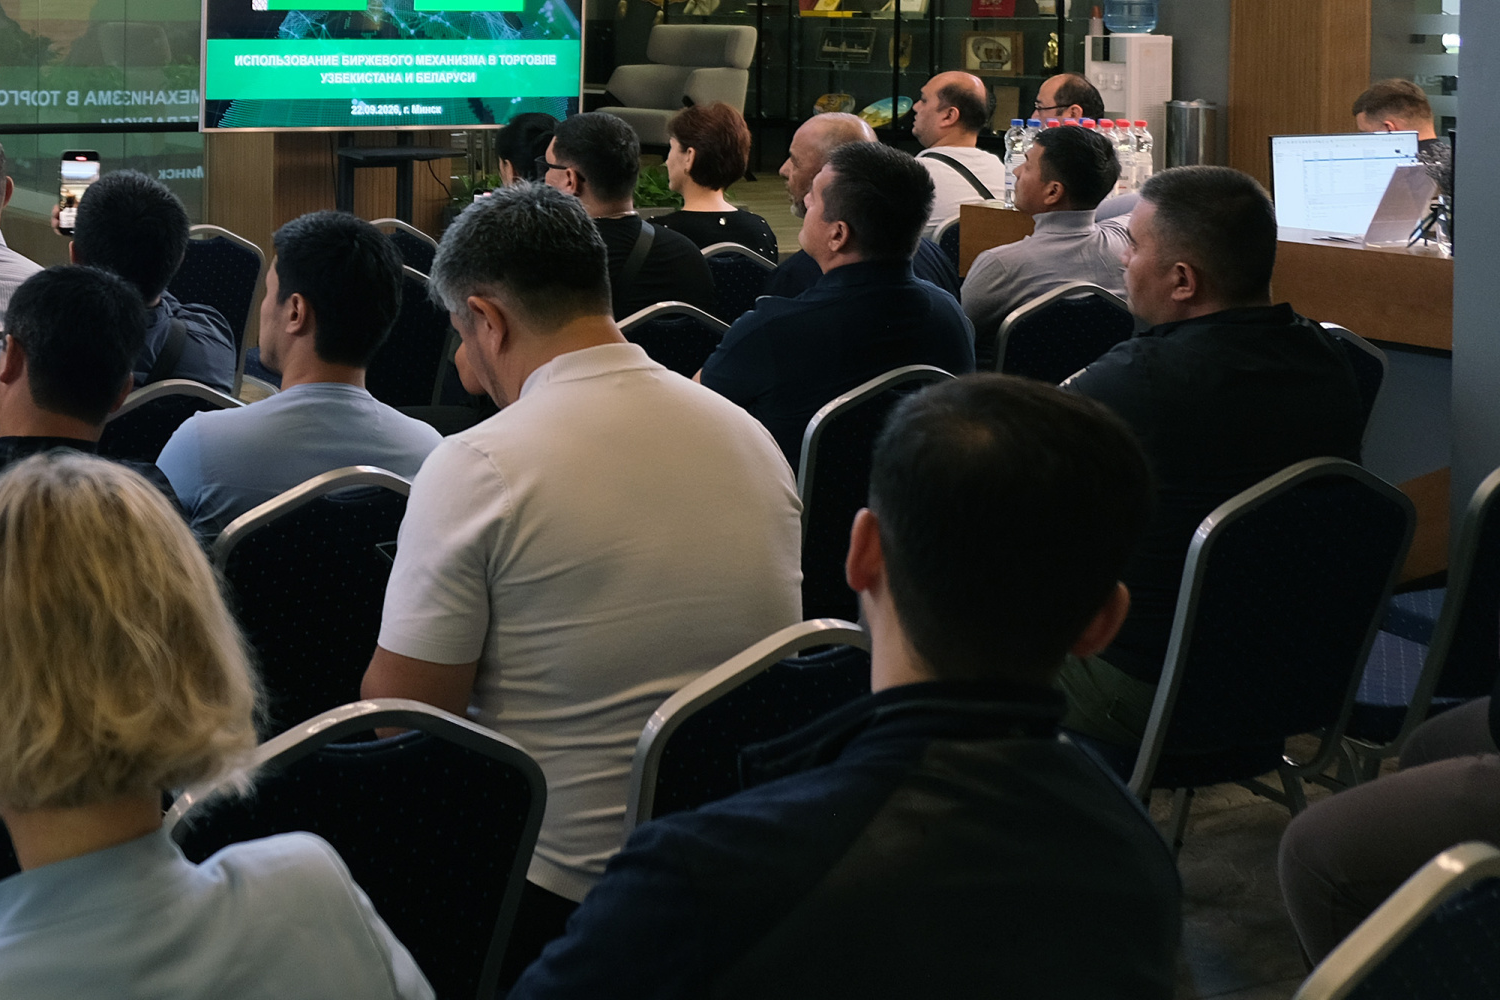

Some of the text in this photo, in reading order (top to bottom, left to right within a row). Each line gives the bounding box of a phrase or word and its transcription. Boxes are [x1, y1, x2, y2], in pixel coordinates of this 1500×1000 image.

[234, 54, 557, 67] ИСПОЛЬЗОВАНИЕ БИРЖЕВОГО МЕХАНИЗМА В ТОРГОВЛЕ
[320, 72, 476, 84] УЗБЕКИСТАНА И БЕЛАРУСИ
[351, 105, 402, 116] 22.09.2026,
[411, 104, 443, 115] Минск
